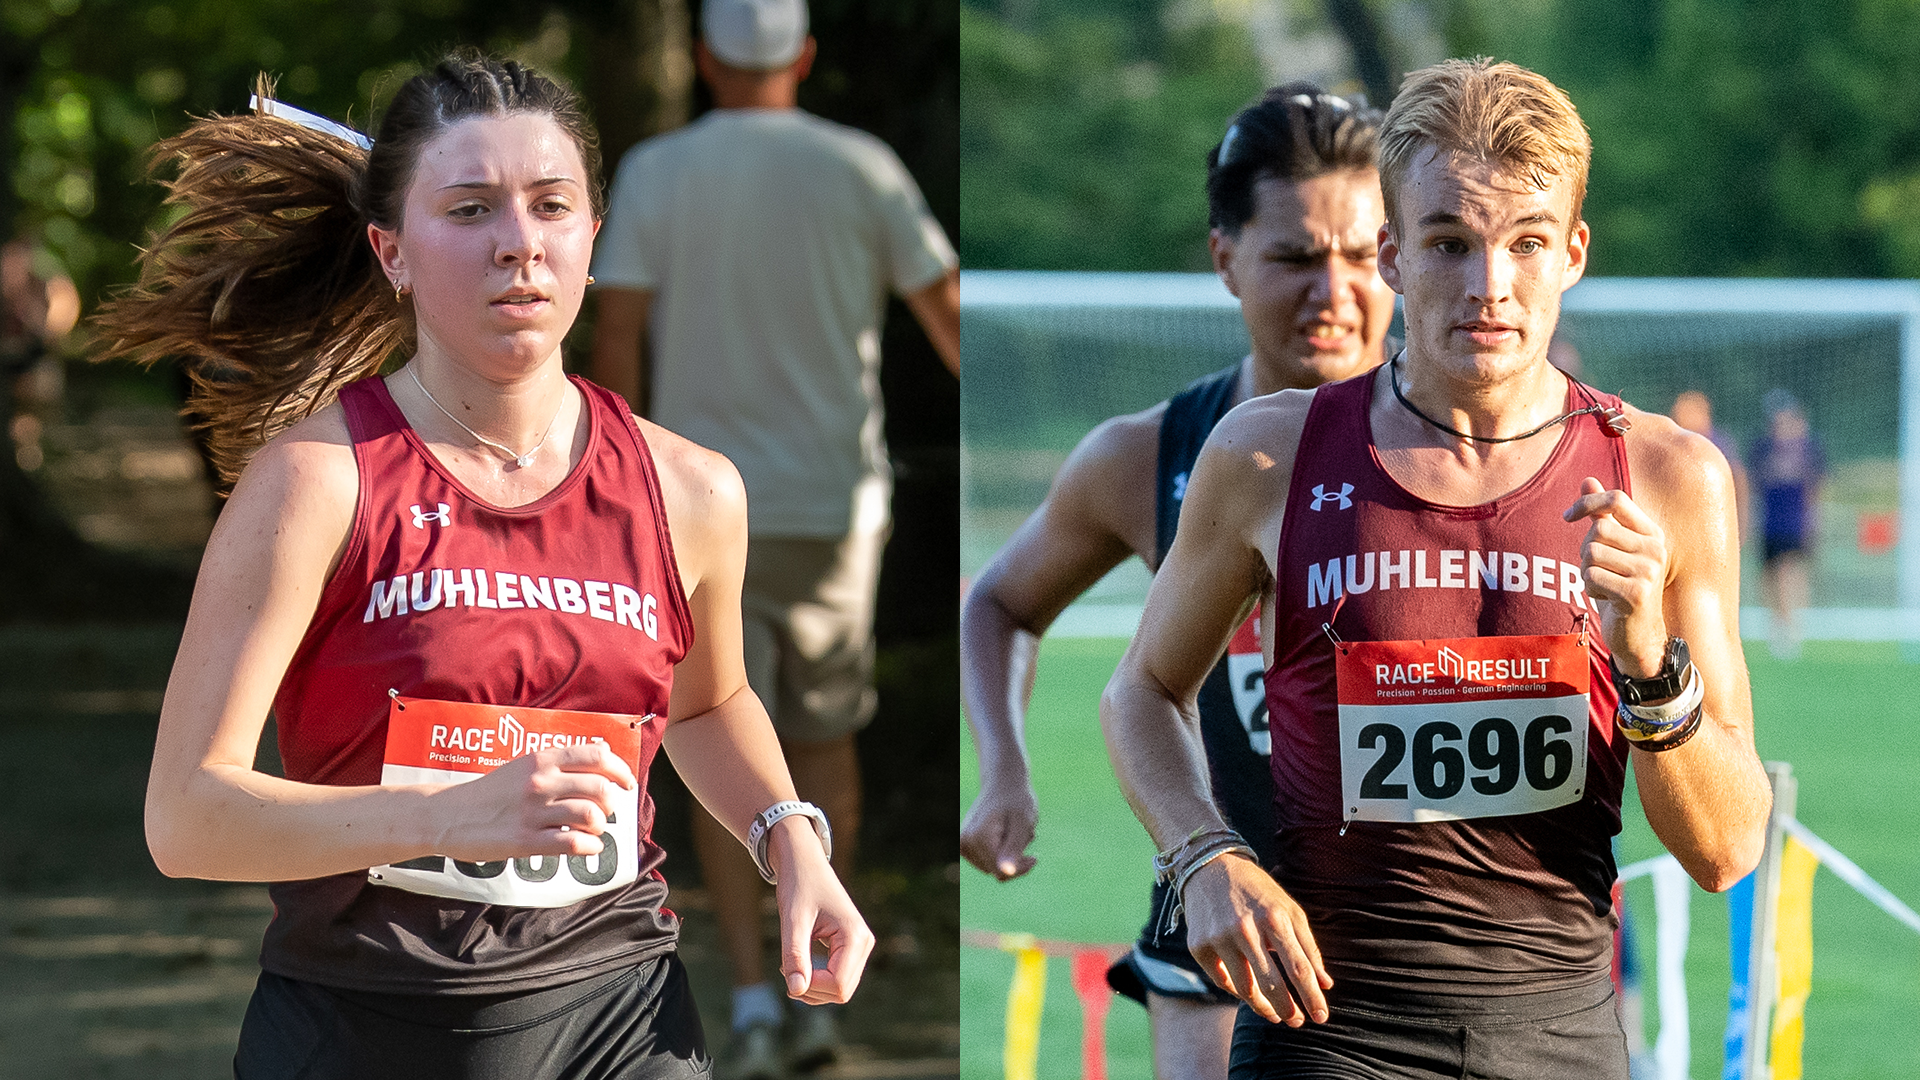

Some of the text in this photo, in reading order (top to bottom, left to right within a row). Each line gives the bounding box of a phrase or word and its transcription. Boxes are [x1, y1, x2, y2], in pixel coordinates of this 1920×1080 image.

[1307, 550, 1599, 614] MUHLENBER
[363, 568, 659, 641] MUHLENBERG
[1375, 658, 1550, 685] RACE RESULT
[1376, 682, 1547, 698] Precision Passion German Engineering
[431, 724, 495, 753] RACE
[429, 751, 510, 767] Precision Passio
[1357, 715, 1573, 800] 2696
